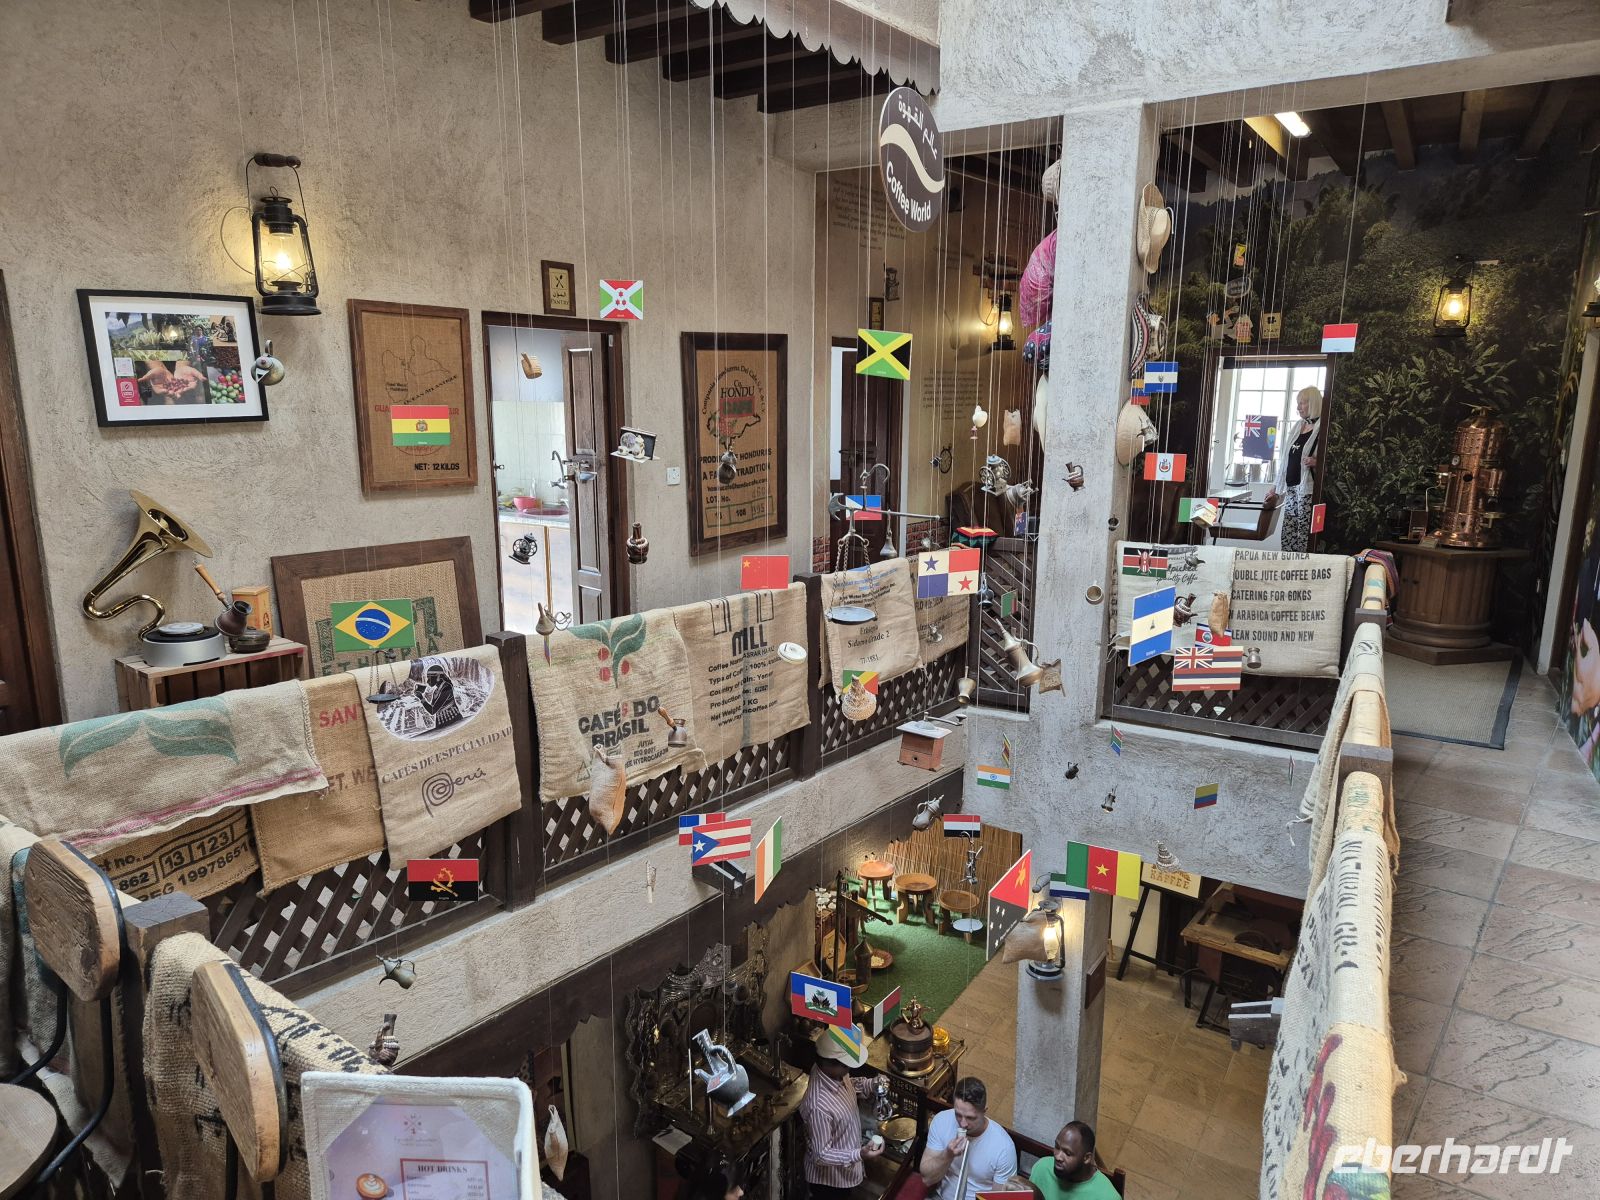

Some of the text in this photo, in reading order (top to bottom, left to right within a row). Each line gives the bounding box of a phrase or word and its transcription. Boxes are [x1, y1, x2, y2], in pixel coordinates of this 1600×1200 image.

[886, 161, 931, 222] Coffee World
[720, 385, 755, 399] HONDU
[739, 447, 772, 461] HONDURAS
[414, 463, 430, 471] NET:
[736, 462, 771, 477] TRADITION
[1235, 550, 1310, 561] PAPUA NEW GUINEA
[1233, 567, 1332, 581] OUBLE JUTE COFFEE BAGS
[1231, 590, 1312, 601] CATERING FOR 60KGS
[1236, 610, 1269, 621] ARABICA
[1271, 610, 1299, 622] COFFEE
[1301, 610, 1326, 621] BEANS
[885, 630, 891, 638] 2
[1232, 629, 1315, 642] LEAN SOUND AND NEW
[708, 660, 729, 673] Coffee
[708, 675, 724, 686] Type
[725, 672, 732, 681] of
[709, 685, 733, 697] Country
[733, 681, 740, 690] of
[633, 695, 660, 718] DO
[710, 693, 742, 709] Production
[319, 704, 360, 728] SAN
[710, 713, 721, 722] Net
[747, 698, 759, 706] KG
[591, 718, 650, 748] BRASIL
[381, 762, 419, 784] CAFÉS
[419, 755, 435, 770] DE
[329, 773, 348, 795] ET.
[421, 766, 487, 818] Perú
[164, 831, 230, 870] 13 123
[118, 871, 150, 892] 862
[417, 1164, 468, 1174] HOT DRINKS
